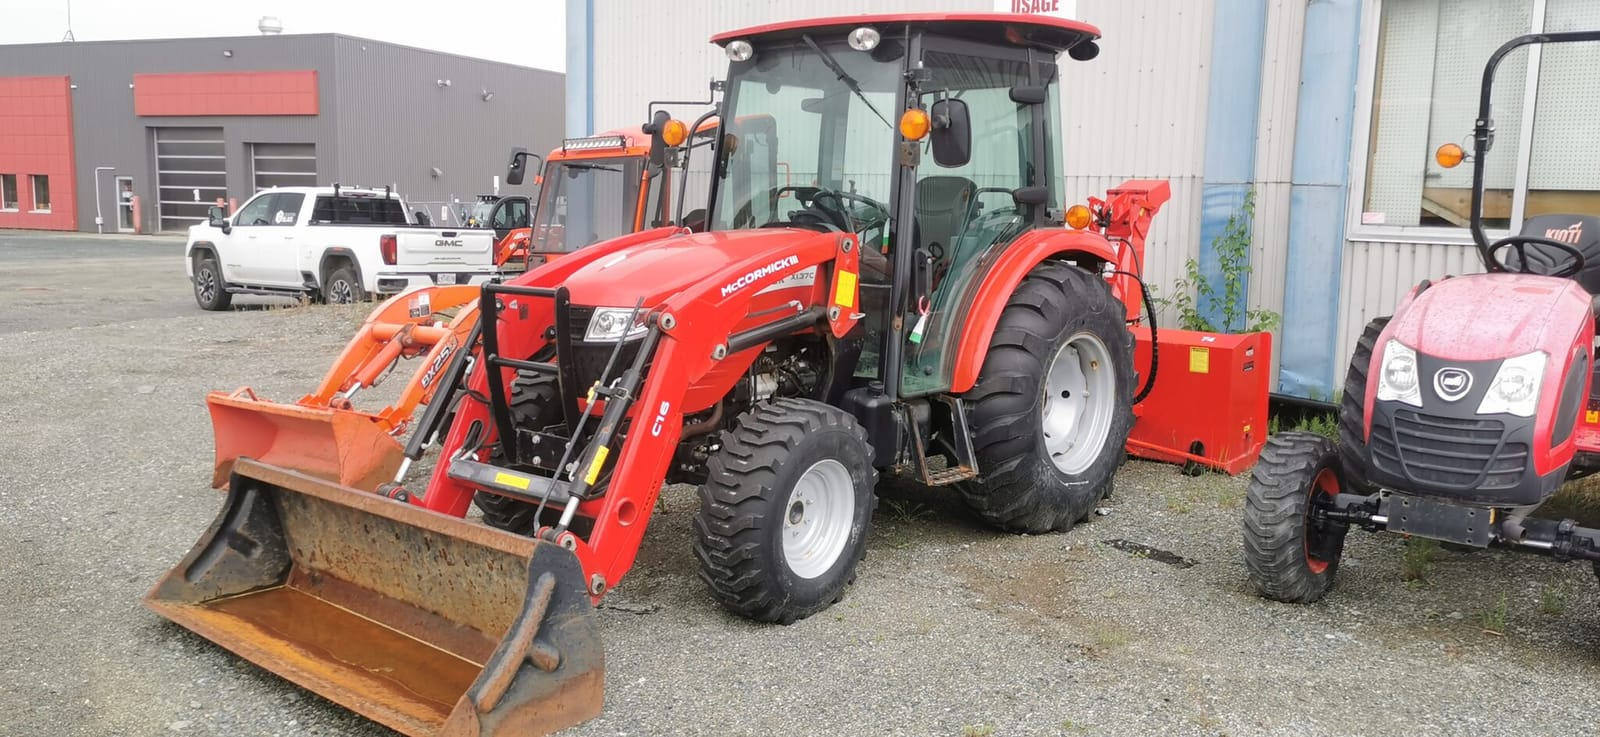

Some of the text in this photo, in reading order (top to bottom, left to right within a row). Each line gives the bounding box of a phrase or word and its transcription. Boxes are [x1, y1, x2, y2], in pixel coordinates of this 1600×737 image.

[1545, 221, 1582, 243] KIOTI
[720, 256, 793, 297] McCORMICK
[652, 401, 670, 437] C16
